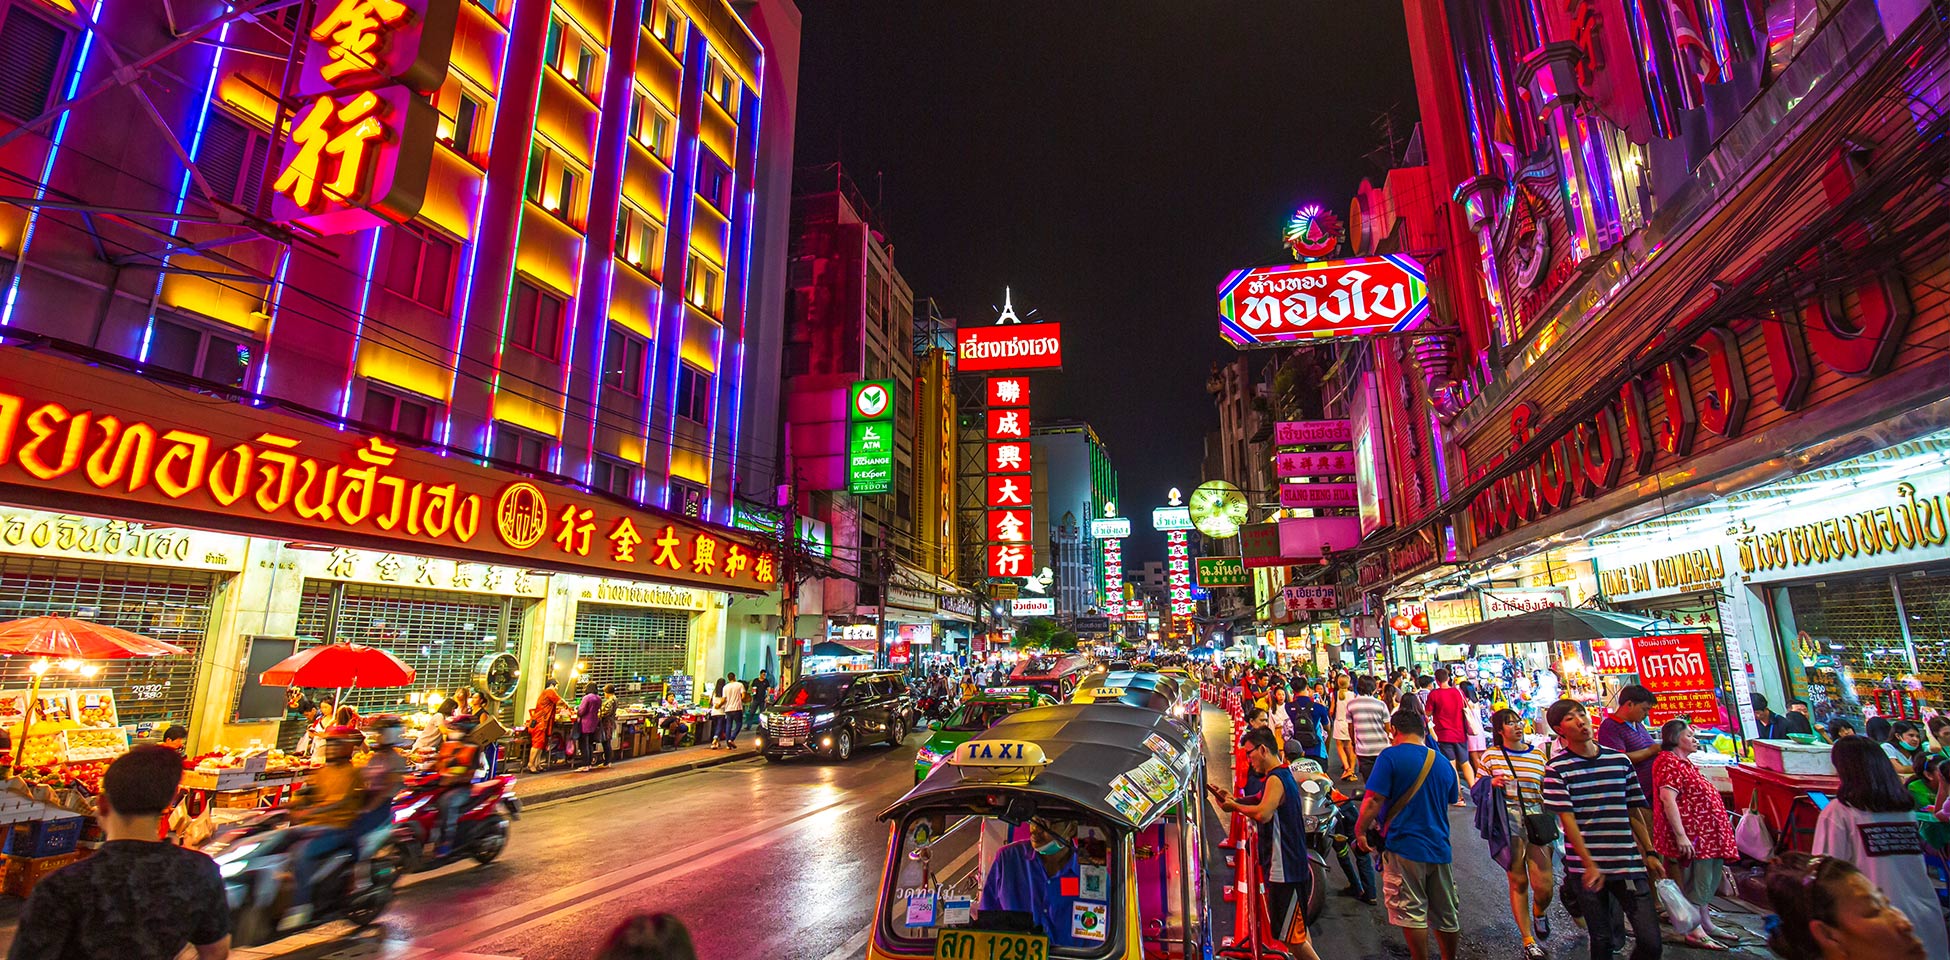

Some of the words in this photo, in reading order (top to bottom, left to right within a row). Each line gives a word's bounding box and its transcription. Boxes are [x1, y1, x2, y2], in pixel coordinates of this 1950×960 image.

[1248, 275, 1328, 294] ห้างทอง
[1240, 269, 1407, 330] ทองใบ
[959, 333, 1059, 360] เลี่ยงเซ่งเฮง
[863, 441, 881, 449] ATM
[853, 468, 887, 479] K-Expert
[995, 379, 1024, 576] 聯成興大金行
[853, 483, 888, 491] WISDOM
[1284, 489, 1309, 502] SIANG
[1309, 489, 1331, 502] HENG
[1333, 488, 1350, 501] HUA
[1735, 482, 1950, 574] ห้างขายทองทองใบ
[1599, 566, 1629, 597] TONG
[1629, 561, 1652, 593] BAI
[1652, 545, 1725, 589] YAOWARAJ
[1096, 687, 1118, 695] TAXI
[967, 743, 1024, 760] TAXI
[941, 932, 976, 960] สก
[988, 935, 1043, 960] 1293
